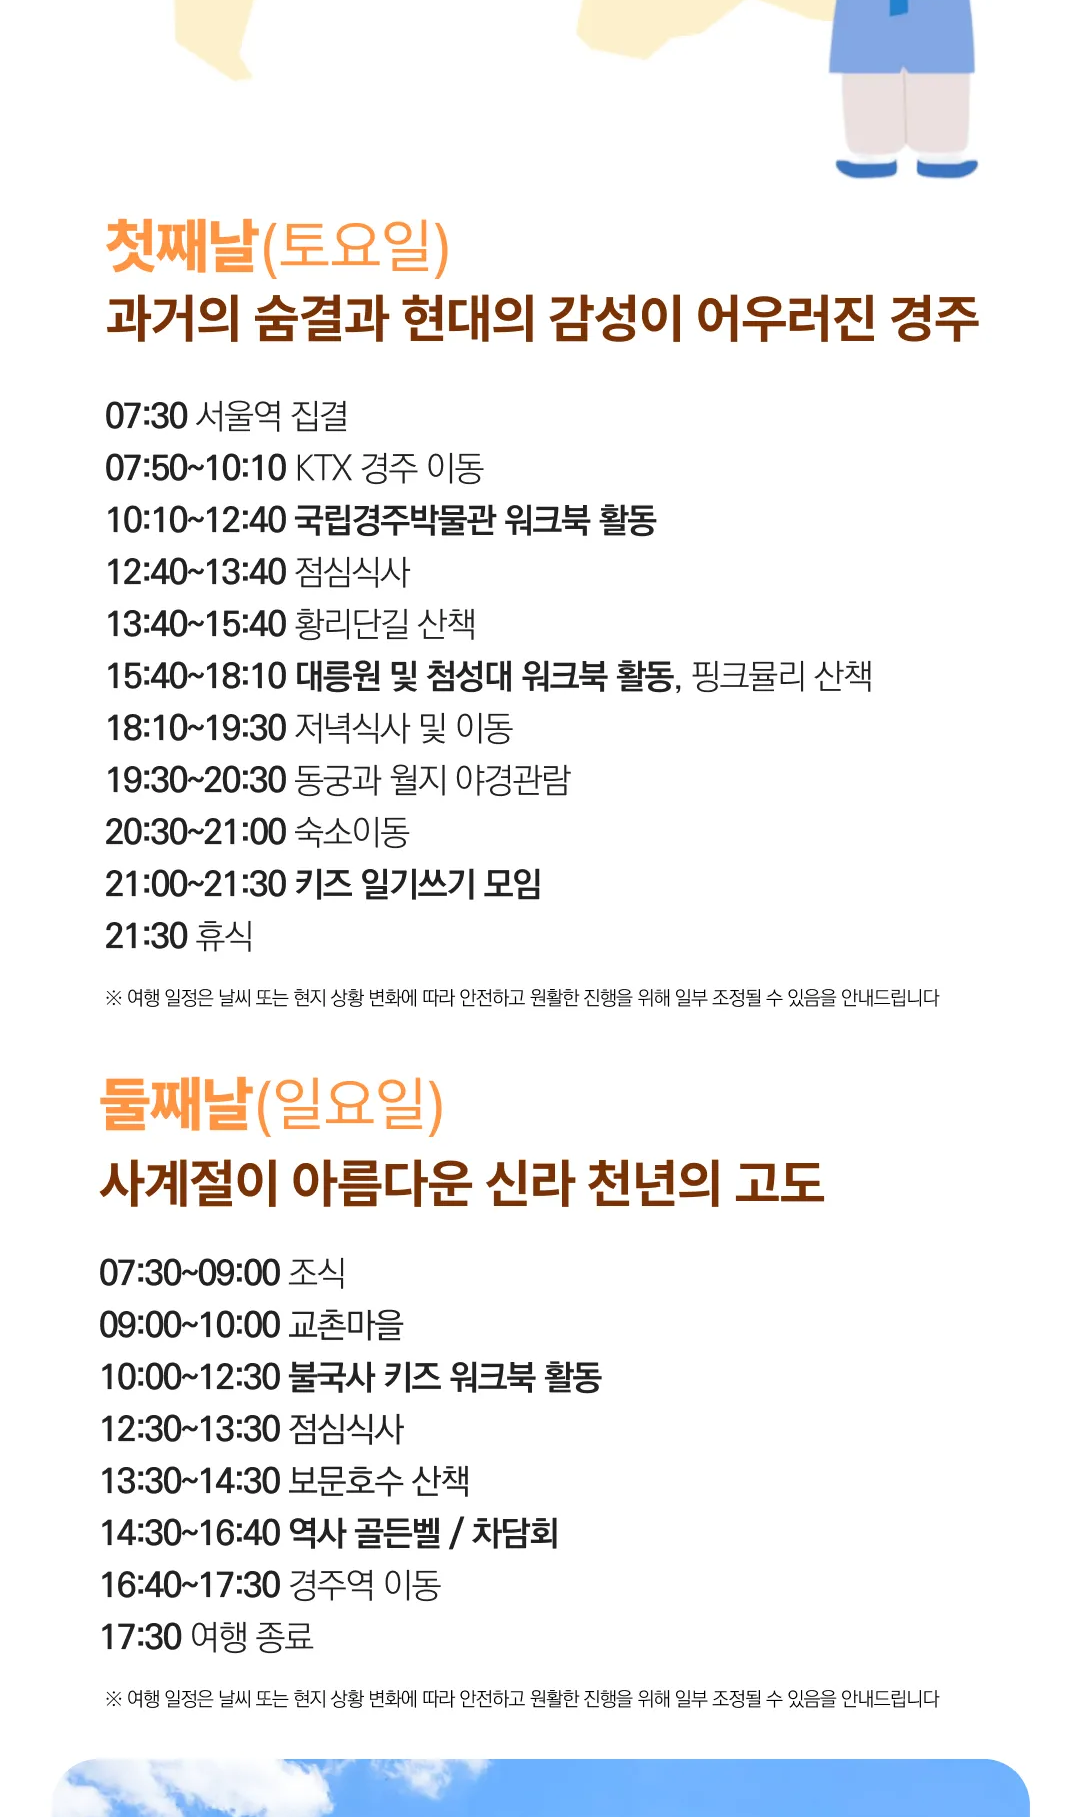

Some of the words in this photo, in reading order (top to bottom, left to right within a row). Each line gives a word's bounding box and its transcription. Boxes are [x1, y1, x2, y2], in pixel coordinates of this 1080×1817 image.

[106, 219, 448, 279] 첫째날(토요일)
[107, 294, 238, 342] 과거의
[255, 294, 390, 342] 숨결과
[402, 294, 533, 342] 현대의
[549, 294, 680, 342] 감성이
[698, 294, 874, 342] 어우러진
[891, 295, 979, 342] 경주
[106, 401, 188, 429] 07:30
[196, 400, 280, 432] 서울역
[291, 401, 346, 431] 집결
[106, 453, 286, 481] 07:50~10:10
[298, 454, 352, 481] KTX
[362, 453, 418, 484] 경주
[428, 453, 484, 484] 이동
[108, 505, 286, 533] 10:10~12:40
[295, 504, 497, 536] 국립경주박물관
[505, 504, 591, 536] 워크북
[599, 504, 657, 536] 활동
[108, 661, 286, 689] 15:40~18:10
[297, 660, 380, 692] 대릉원
[391, 661, 417, 692] 및
[427, 660, 511, 692] 첨성대
[522, 661, 608, 692] 워크북
[617, 660, 681, 693] 활동,
[692, 661, 803, 692] 핑크뮬리
[814, 661, 871, 692] 산책
[108, 765, 286, 793] 19:30~20:30
[295, 765, 382, 796] 동궁과
[391, 764, 445, 796] 월지
[457, 765, 571, 796] 야경관람
[106, 869, 286, 897] 21:00~21:30
[296, 869, 352, 900] 키즈
[362, 869, 474, 900] 일기쓰기
[484, 868, 540, 900] 모임
[106, 921, 188, 949] 21:30
[196, 921, 251, 952] 휴식
[128, 989, 159, 1007] 여행
[165, 989, 214, 1007] 일정은
[220, 989, 250, 1007] 날씨
[256, 989, 289, 1007] 또는
[294, 989, 325, 1007] 현지
[331, 989, 364, 1007] 상황
[370, 989, 416, 1007] 변화에
[423, 989, 455, 1007] 따라
[460, 989, 525, 1007] 안전하고
[530, 989, 579, 1007] 원활한
[584, 989, 633, 1007] 진행을
[638, 989, 669, 1007] 위해
[676, 989, 708, 1007] 일부
[712, 989, 761, 1007] 조정될
[766, 989, 783, 1007] 수
[788, 989, 836, 1007] 있음을
[842, 989, 940, 1007] 안내드립니다
[100, 1077, 442, 1137] 둘째날(일요일)
[100, 1159, 276, 1207] 사계절이
[293, 1159, 472, 1207] 아름다운
[486, 1159, 576, 1207] 신라
[588, 1159, 719, 1207] 천년의
[736, 1163, 824, 1202] 고도
[100, 1258, 280, 1286] 07:30~09:00
[289, 1258, 343, 1289] 조식
[102, 1362, 280, 1390] 10:00~12:30
[289, 1361, 375, 1393] 불국사
[385, 1362, 441, 1393] 키즈
[450, 1361, 536, 1393] 워크북
[545, 1361, 602, 1394] 활동
[102, 1466, 280, 1494] 13:30~14:30
[289, 1466, 404, 1497] 보문호수
[412, 1466, 468, 1497] 산책
[102, 1518, 280, 1546] 14:30~16:40
[290, 1517, 347, 1549] 역사
[355, 1518, 440, 1549] 골든벨
[449, 1516, 464, 1550] /
[472, 1518, 557, 1549] 차담회
[102, 1622, 181, 1650] 17:30
[192, 1622, 246, 1653] 여행
[256, 1623, 313, 1653] 종료
